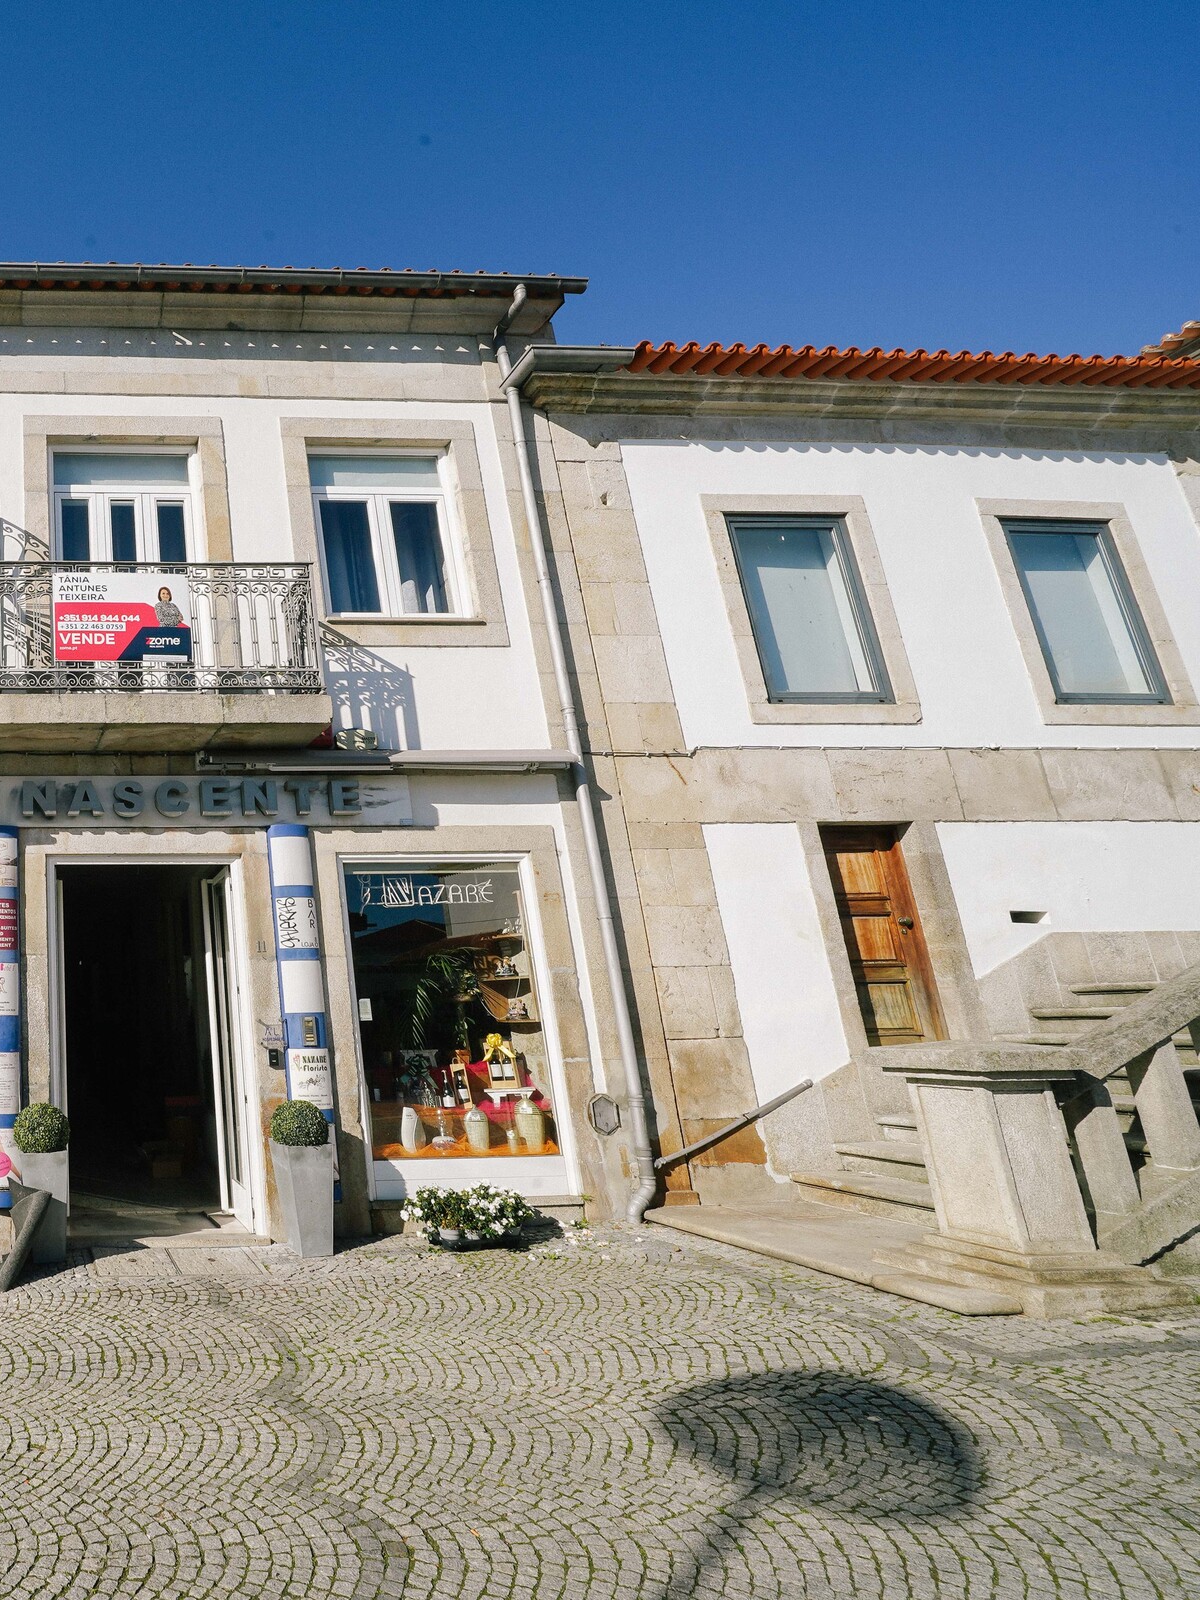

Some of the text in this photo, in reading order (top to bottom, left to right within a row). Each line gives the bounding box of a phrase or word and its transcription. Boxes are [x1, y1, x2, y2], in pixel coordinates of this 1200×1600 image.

[59, 593, 105, 601] TEIXEIRA
[59, 614, 140, 622] +351 914 944 044
[59, 633, 115, 645] VENDE
[21, 779, 363, 818] NASCENTE
